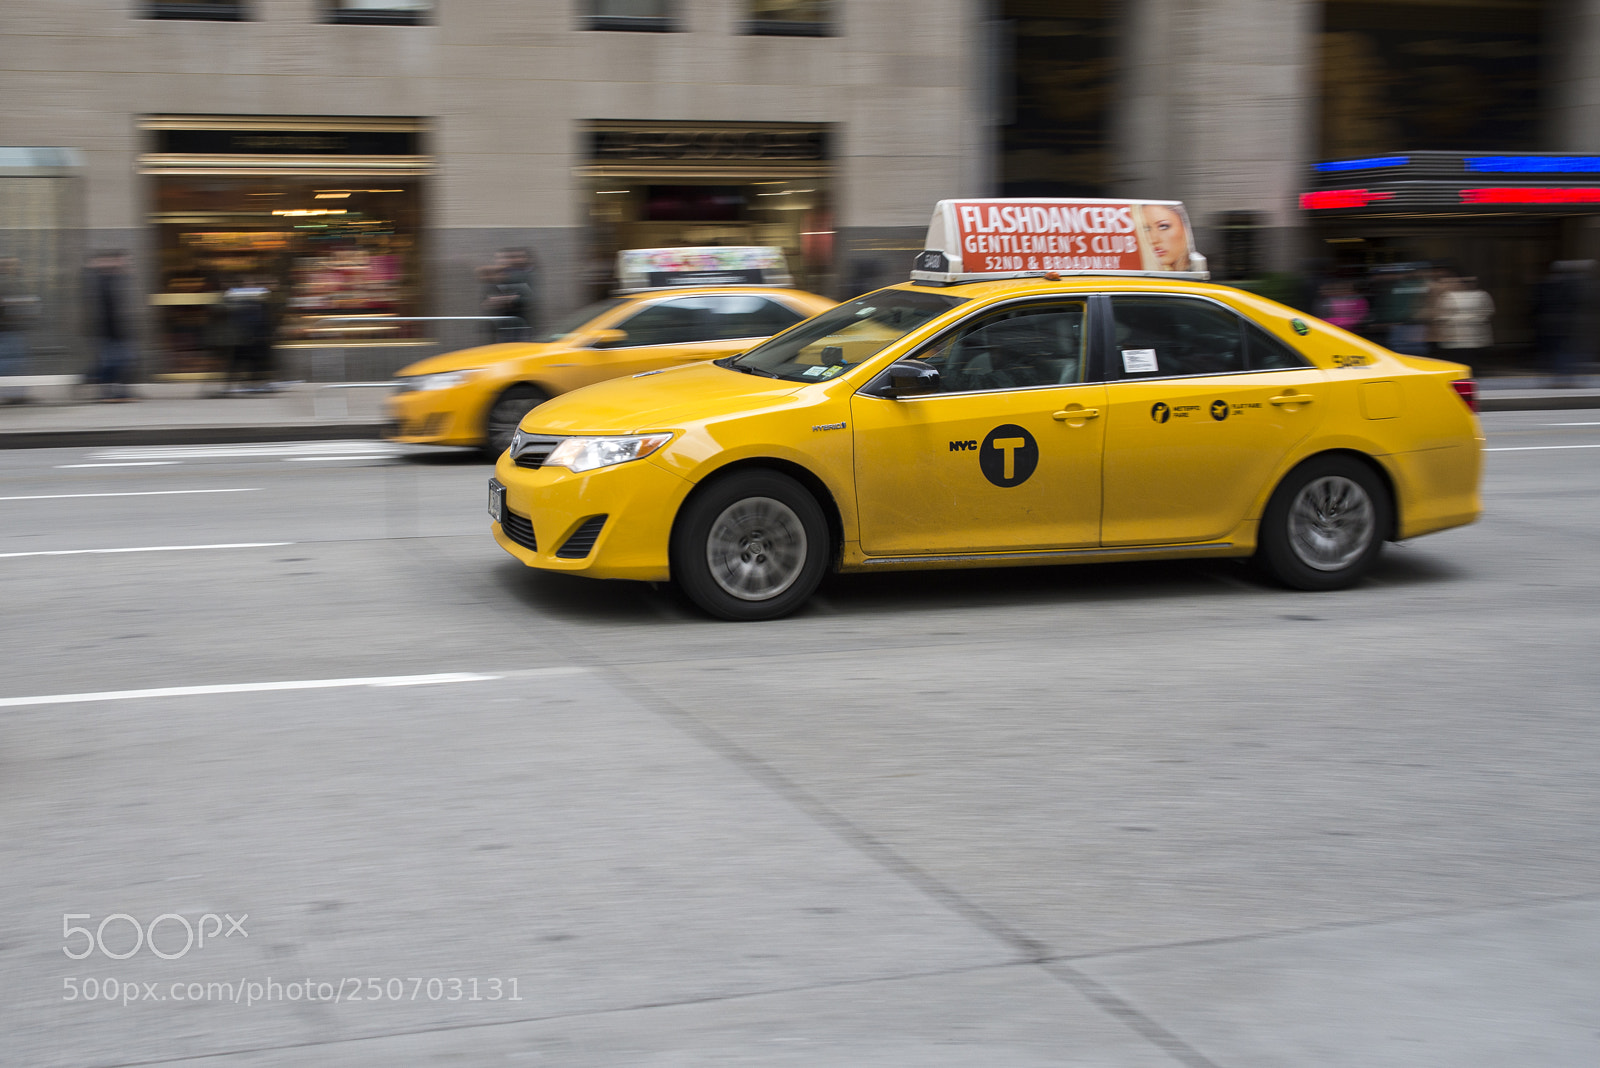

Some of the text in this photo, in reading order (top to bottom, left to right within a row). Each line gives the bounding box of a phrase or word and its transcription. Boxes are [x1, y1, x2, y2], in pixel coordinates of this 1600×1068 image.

[960, 206, 1135, 234] FLASHDANCERS
[965, 235, 1138, 254] GENTLEMEN'S CLUB
[985, 256, 1121, 270] 52ND & BROADWAY
[812, 422, 841, 433] HYBRID
[949, 440, 977, 452] NYC
[993, 437, 1025, 480] T
